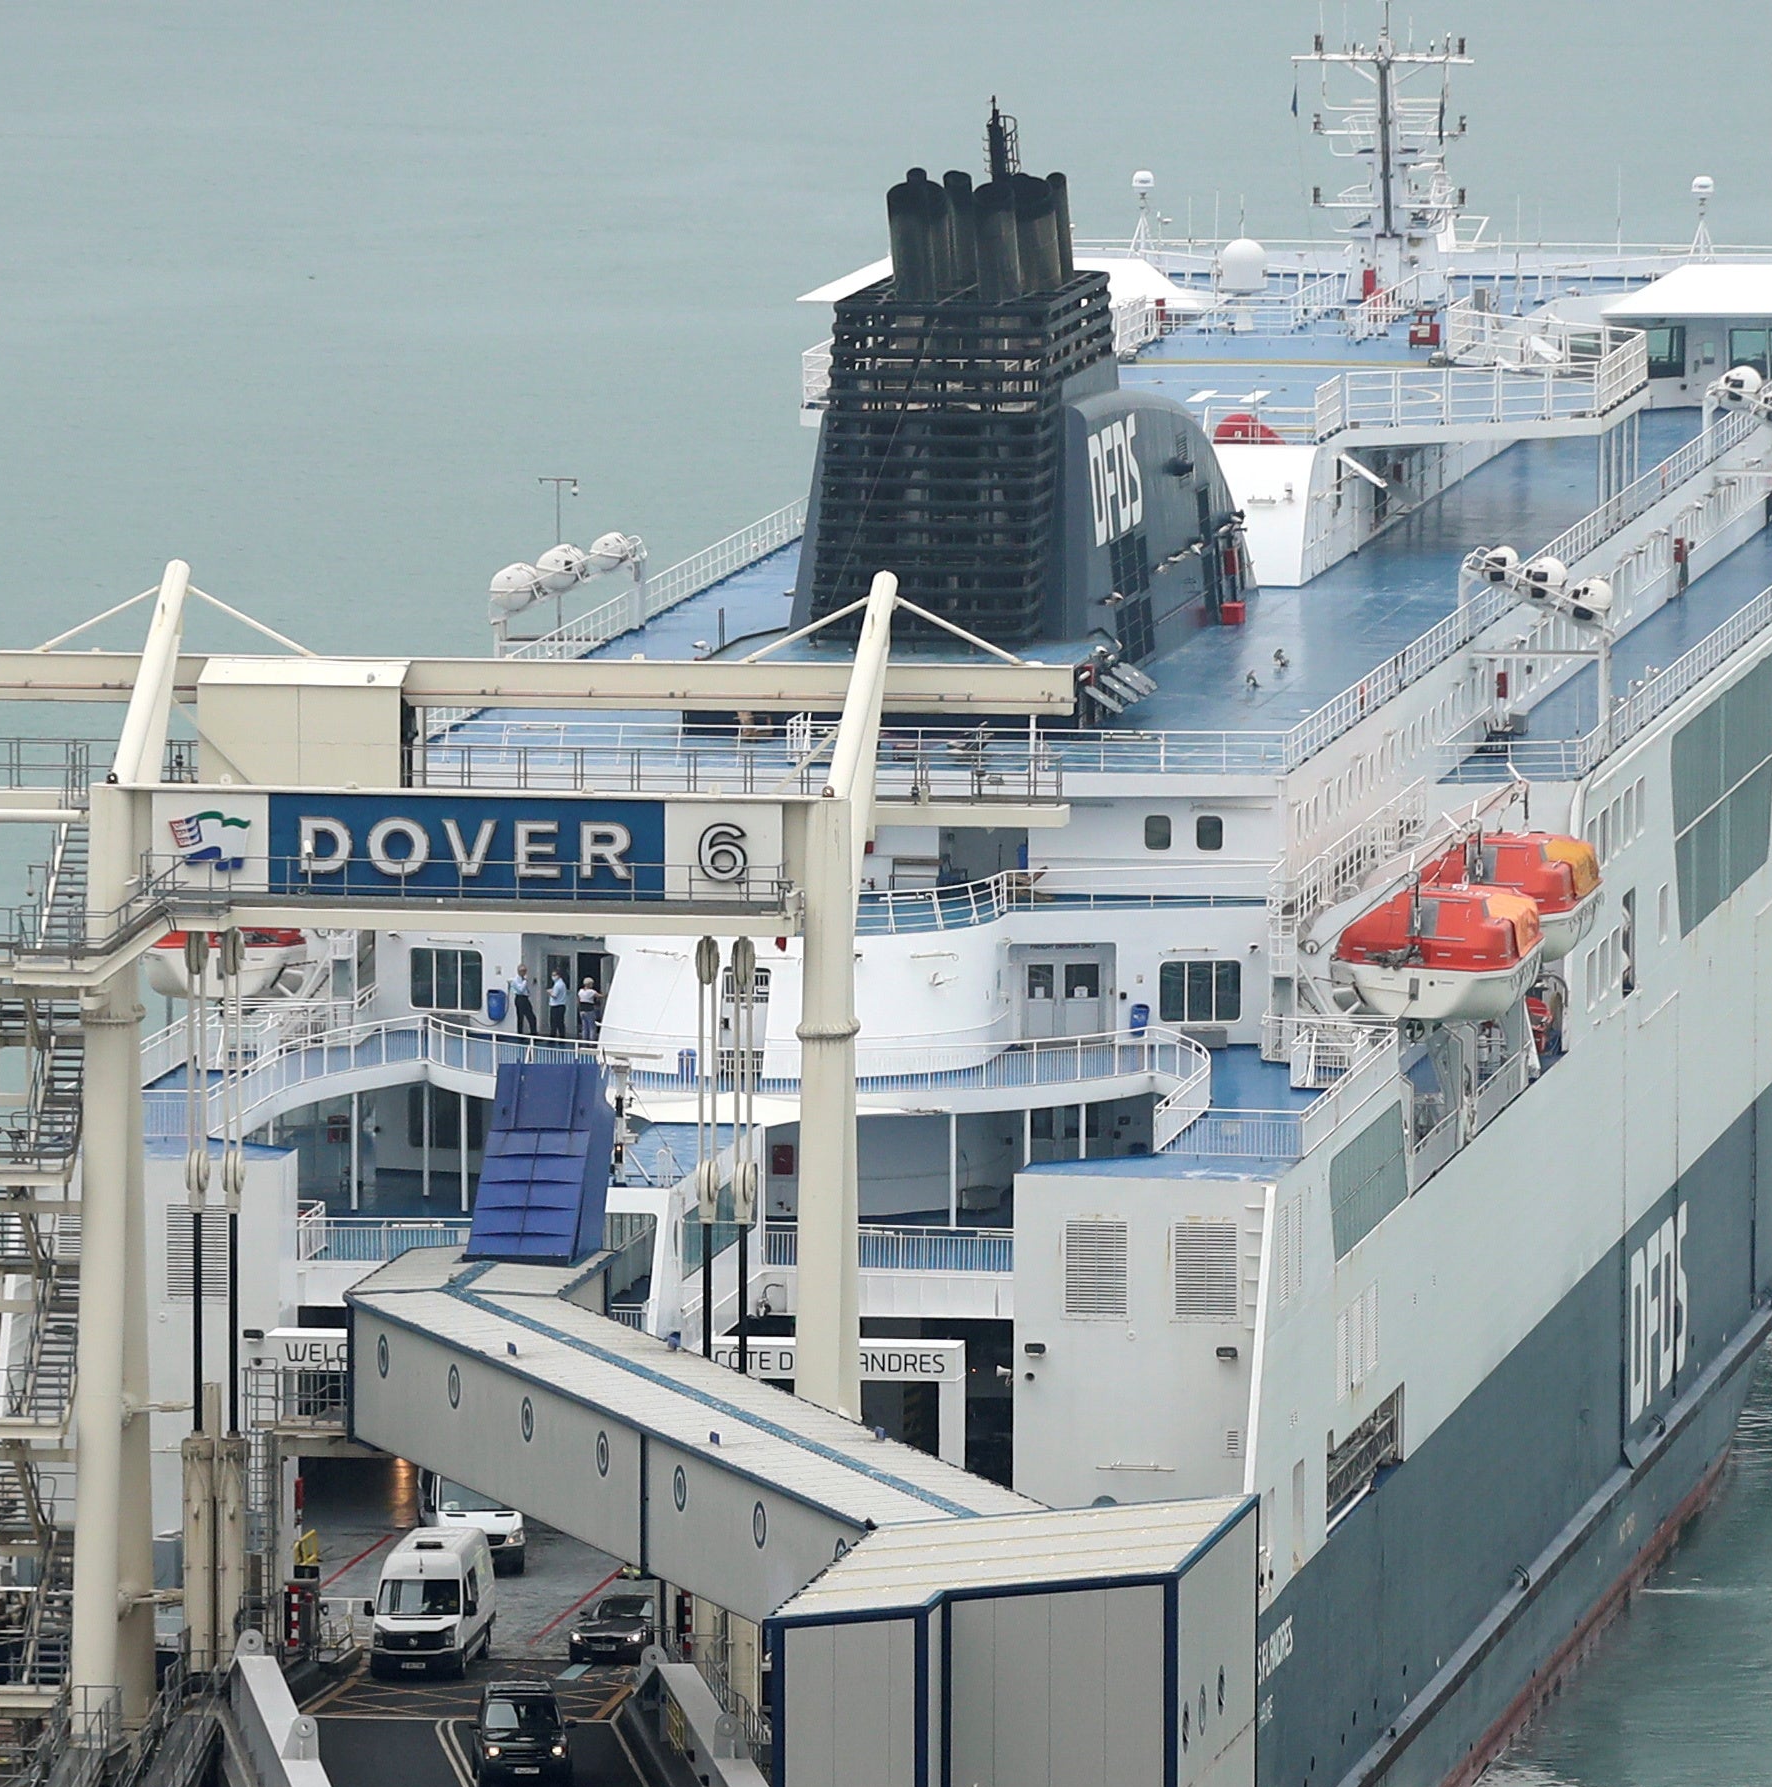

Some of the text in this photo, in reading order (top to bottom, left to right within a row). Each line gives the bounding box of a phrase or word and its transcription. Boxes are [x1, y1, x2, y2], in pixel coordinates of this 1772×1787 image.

[1087, 412, 1144, 548] DFDS
[298, 816, 748, 881] DOVER 6
[1629, 1202, 1688, 1424] DFDS
